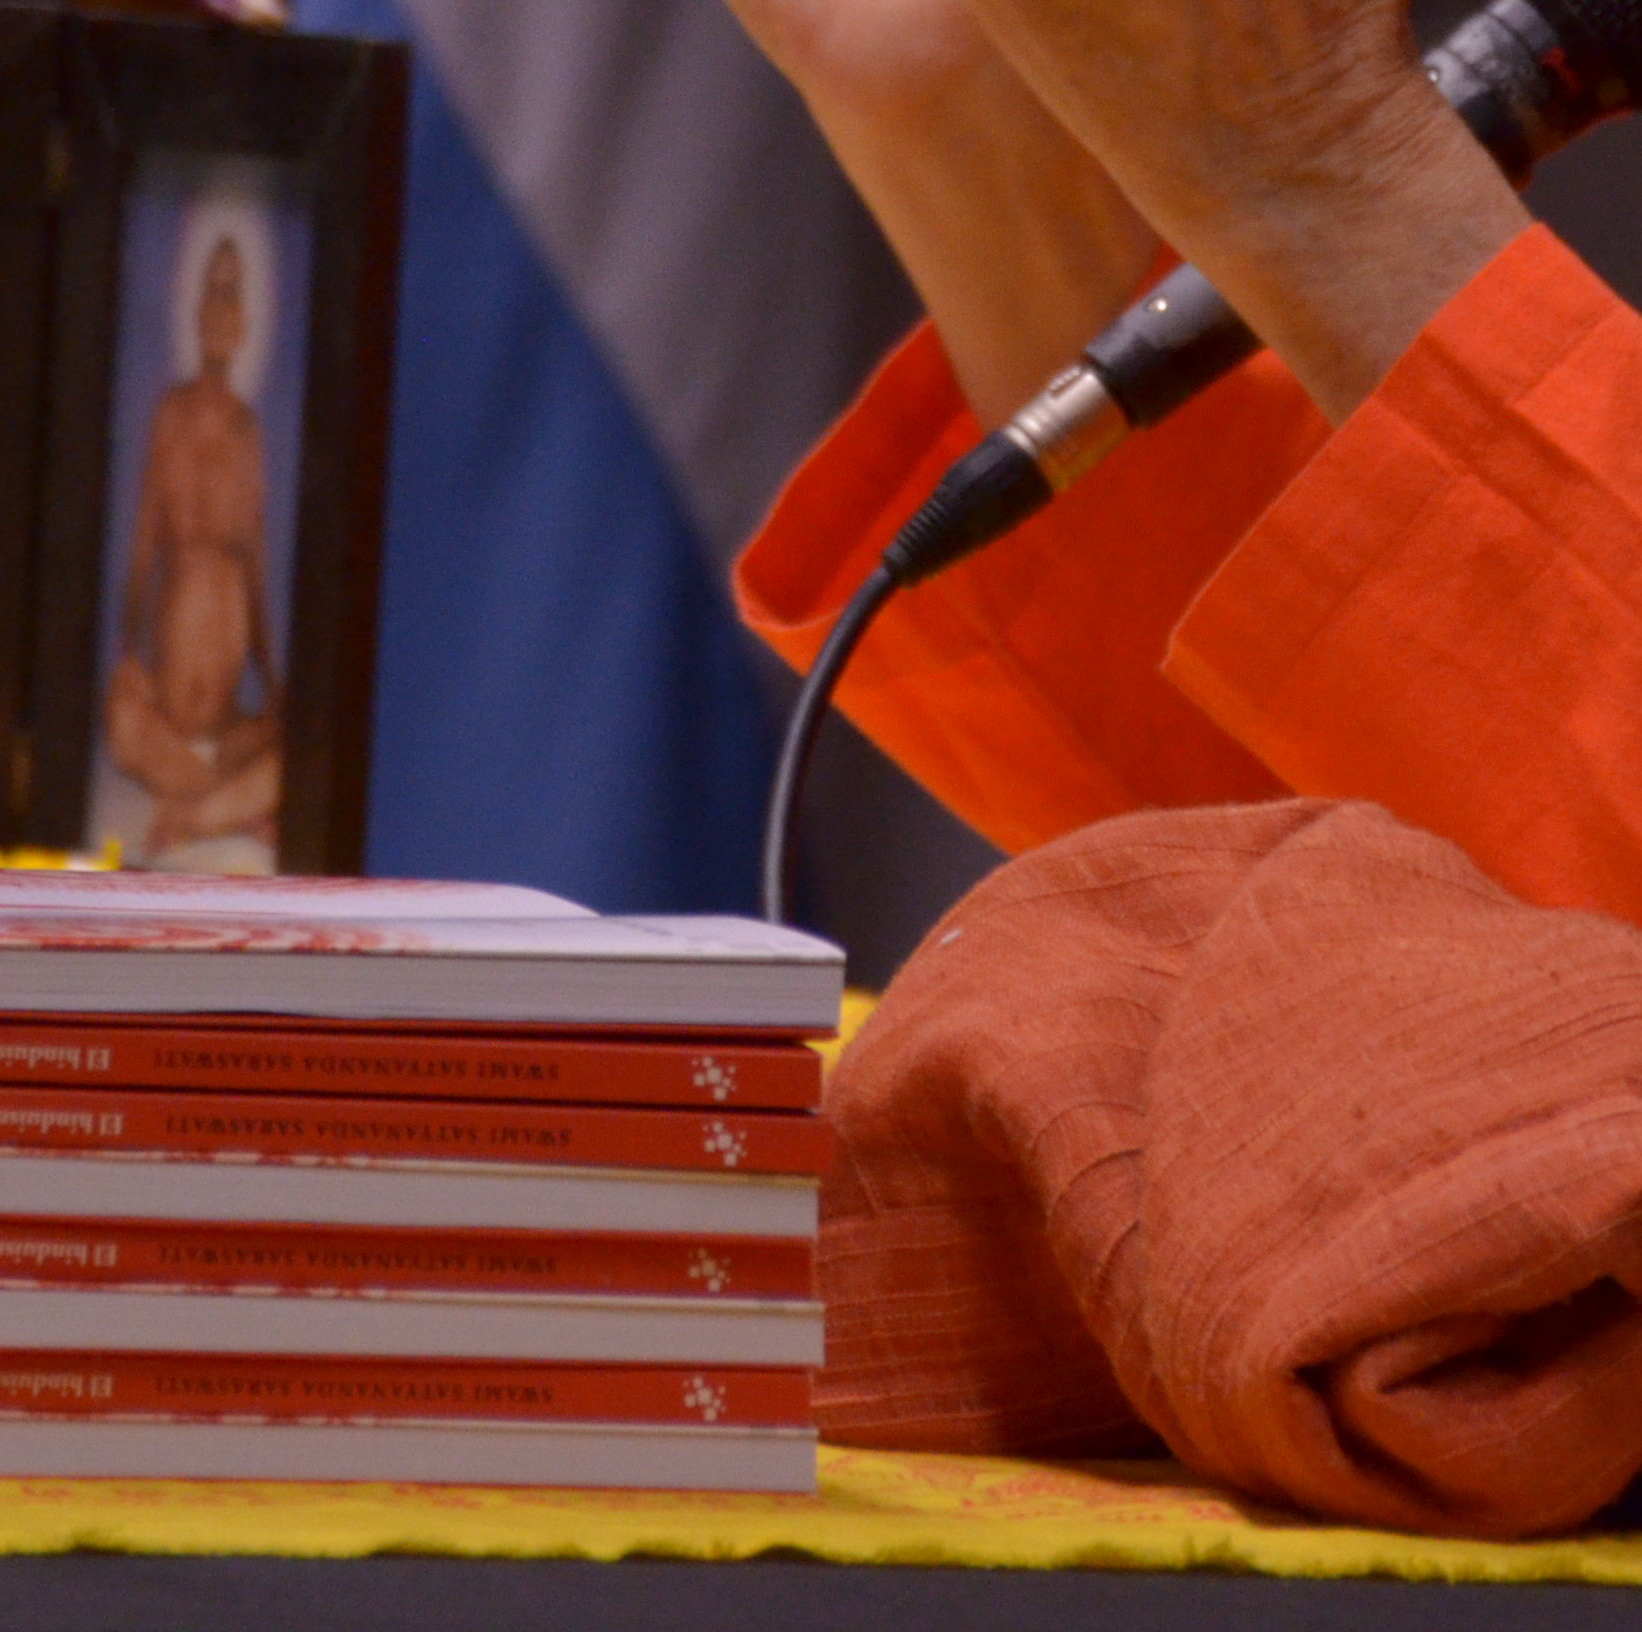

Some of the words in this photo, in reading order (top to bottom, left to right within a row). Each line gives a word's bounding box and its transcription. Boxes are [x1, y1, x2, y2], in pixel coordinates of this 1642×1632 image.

[87, 1047, 112, 1070] El
[154, 1050, 293, 1070] SARASWATI
[302, 1055, 469, 1079] SATYANANDA
[475, 1062, 560, 1081] SWAMI
[99, 1112, 124, 1136] El
[164, 1115, 306, 1136] SARASWATI
[316, 1120, 480, 1144] SATYANANDA
[489, 1126, 572, 1146] SWAMI
[93, 1242, 117, 1268] El
[158, 1246, 297, 1266] SARASWATI
[306, 1250, 469, 1270] SATYANANDA
[476, 1256, 558, 1274] SWAMI
[90, 1373, 114, 1399] El
[156, 1377, 293, 1396] SARASWATI
[301, 1380, 465, 1402] SATYANANDA
[473, 1382, 555, 1404] SWAMI
